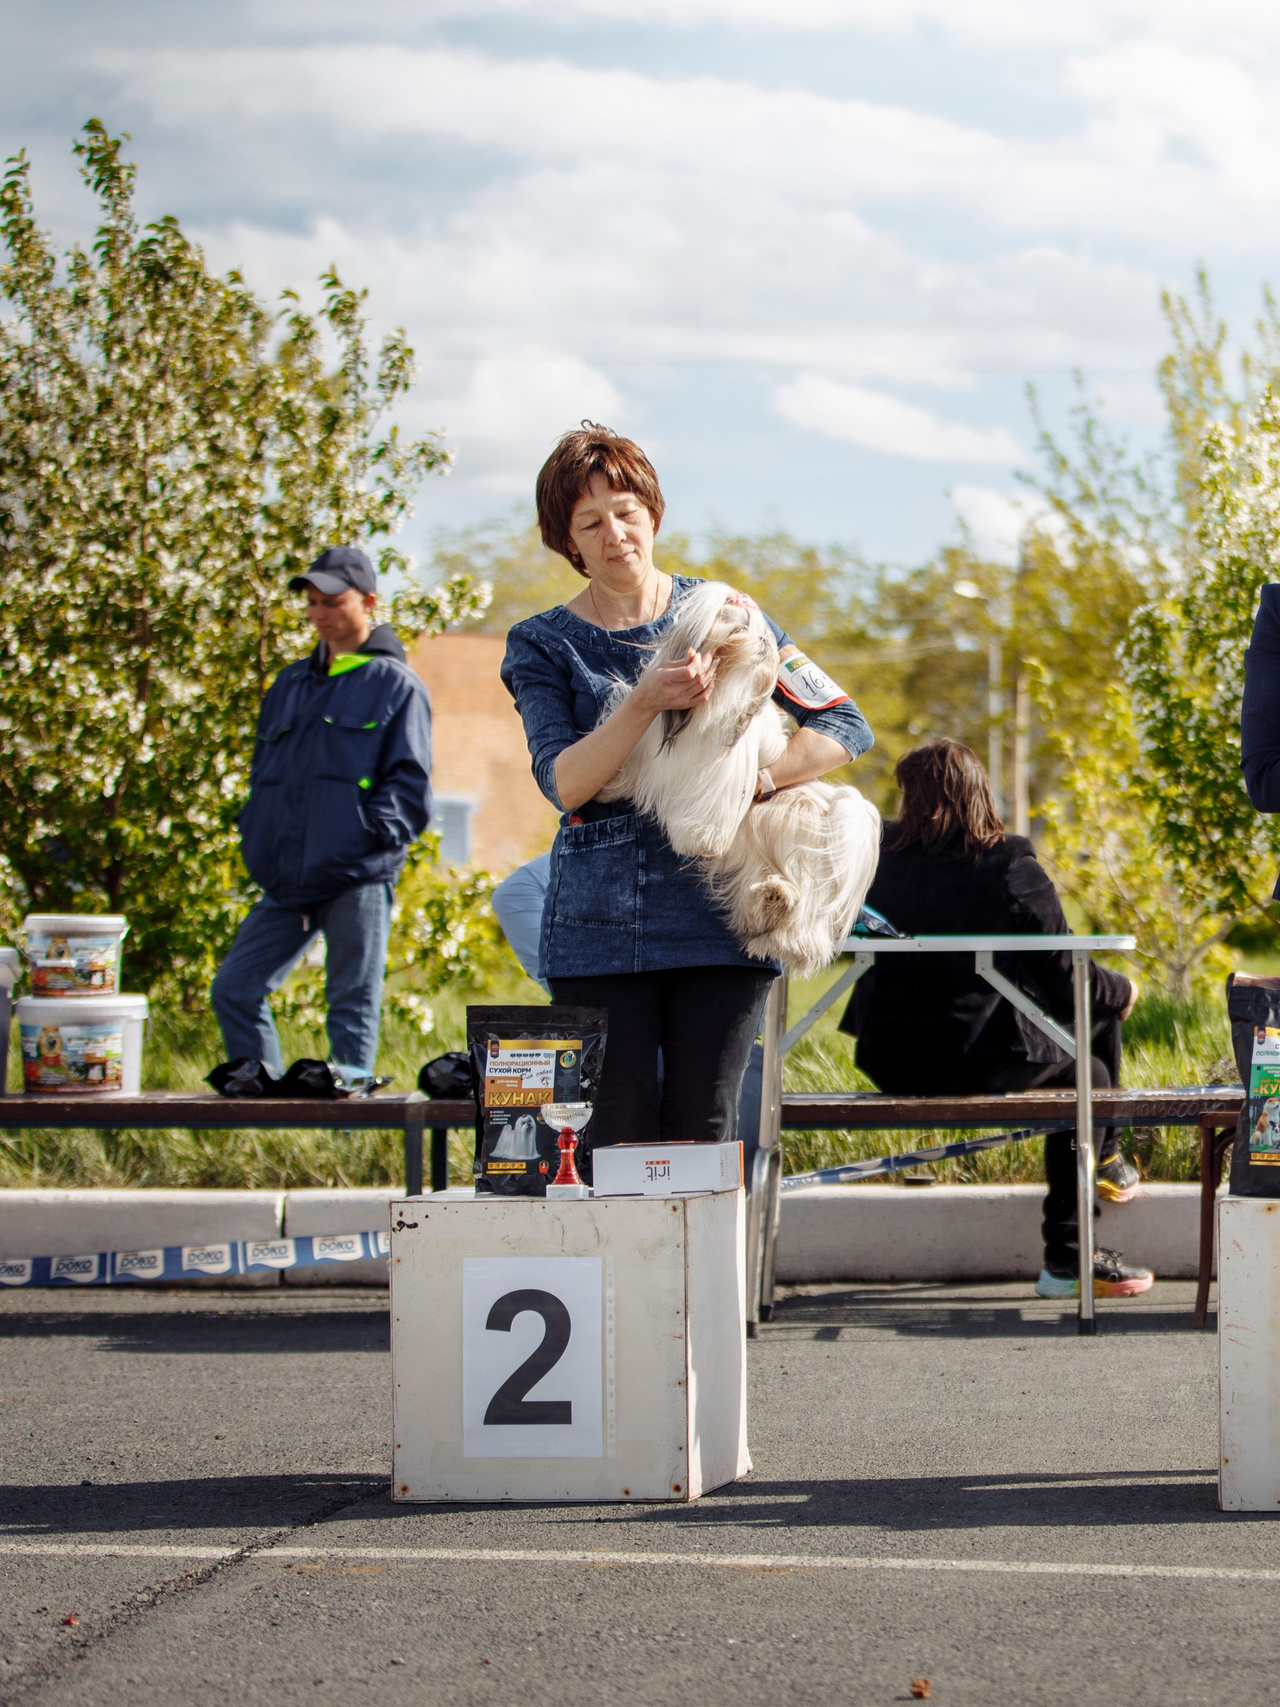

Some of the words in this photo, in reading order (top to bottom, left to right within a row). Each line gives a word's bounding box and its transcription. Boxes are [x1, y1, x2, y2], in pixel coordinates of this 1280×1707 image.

[489, 1059, 551, 1067] ПОЛНОРАЦИОННЫЙ
[489, 1091, 551, 1106] КУНАК
[252, 1245, 288, 1257] DOKO
[319, 1240, 354, 1252] DOKO
[120, 1255, 157, 1268] DOKO
[187, 1250, 224, 1262] DOKO
[0, 1264, 26, 1274] OKO
[55, 1260, 92, 1272] DOKO
[483, 1288, 572, 1426] 2
